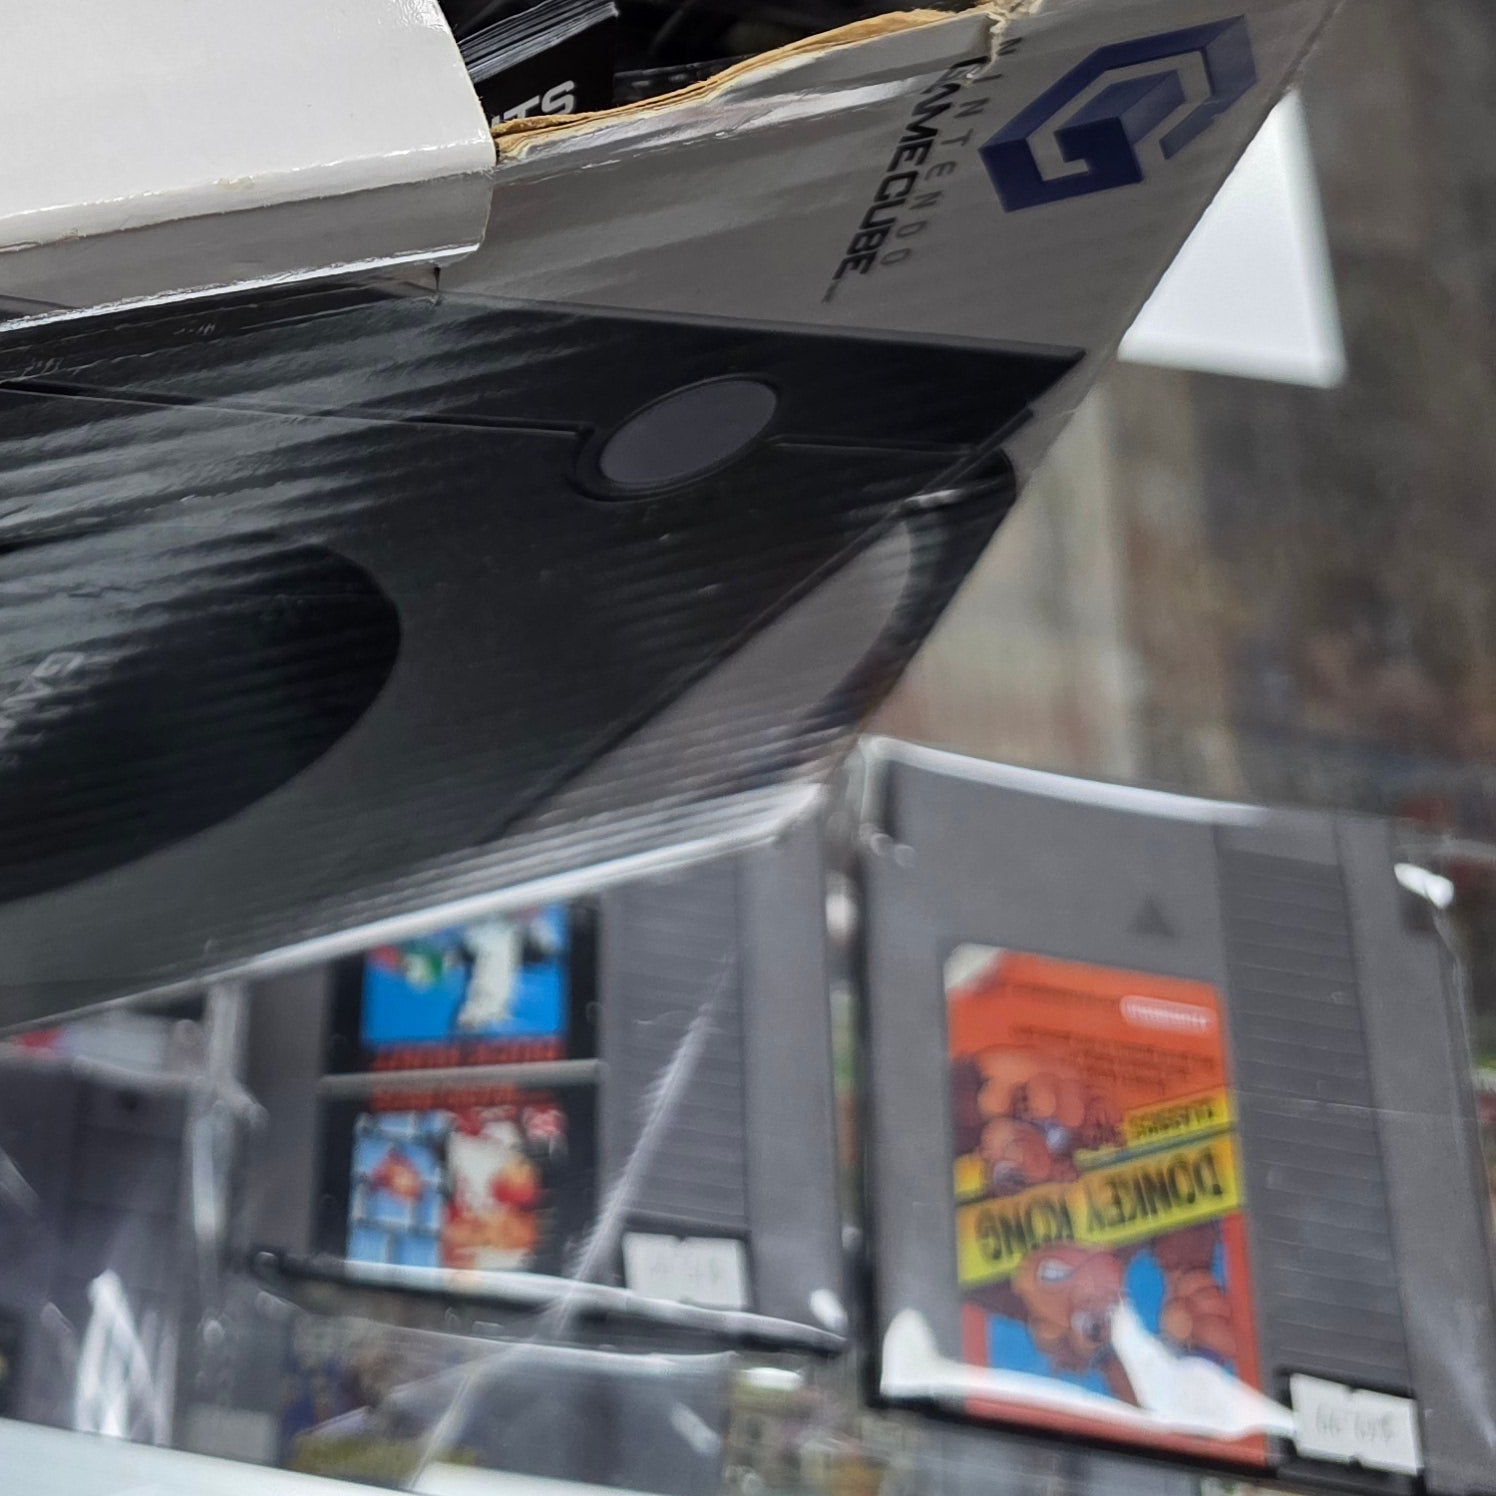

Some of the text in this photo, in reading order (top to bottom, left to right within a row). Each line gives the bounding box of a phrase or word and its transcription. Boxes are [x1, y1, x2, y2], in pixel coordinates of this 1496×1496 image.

[831, 55, 990, 282] GAMECUBE
[879, 36, 1022, 267] NINTENDO
[977, 1144, 1223, 1262] DONKEY KONG
